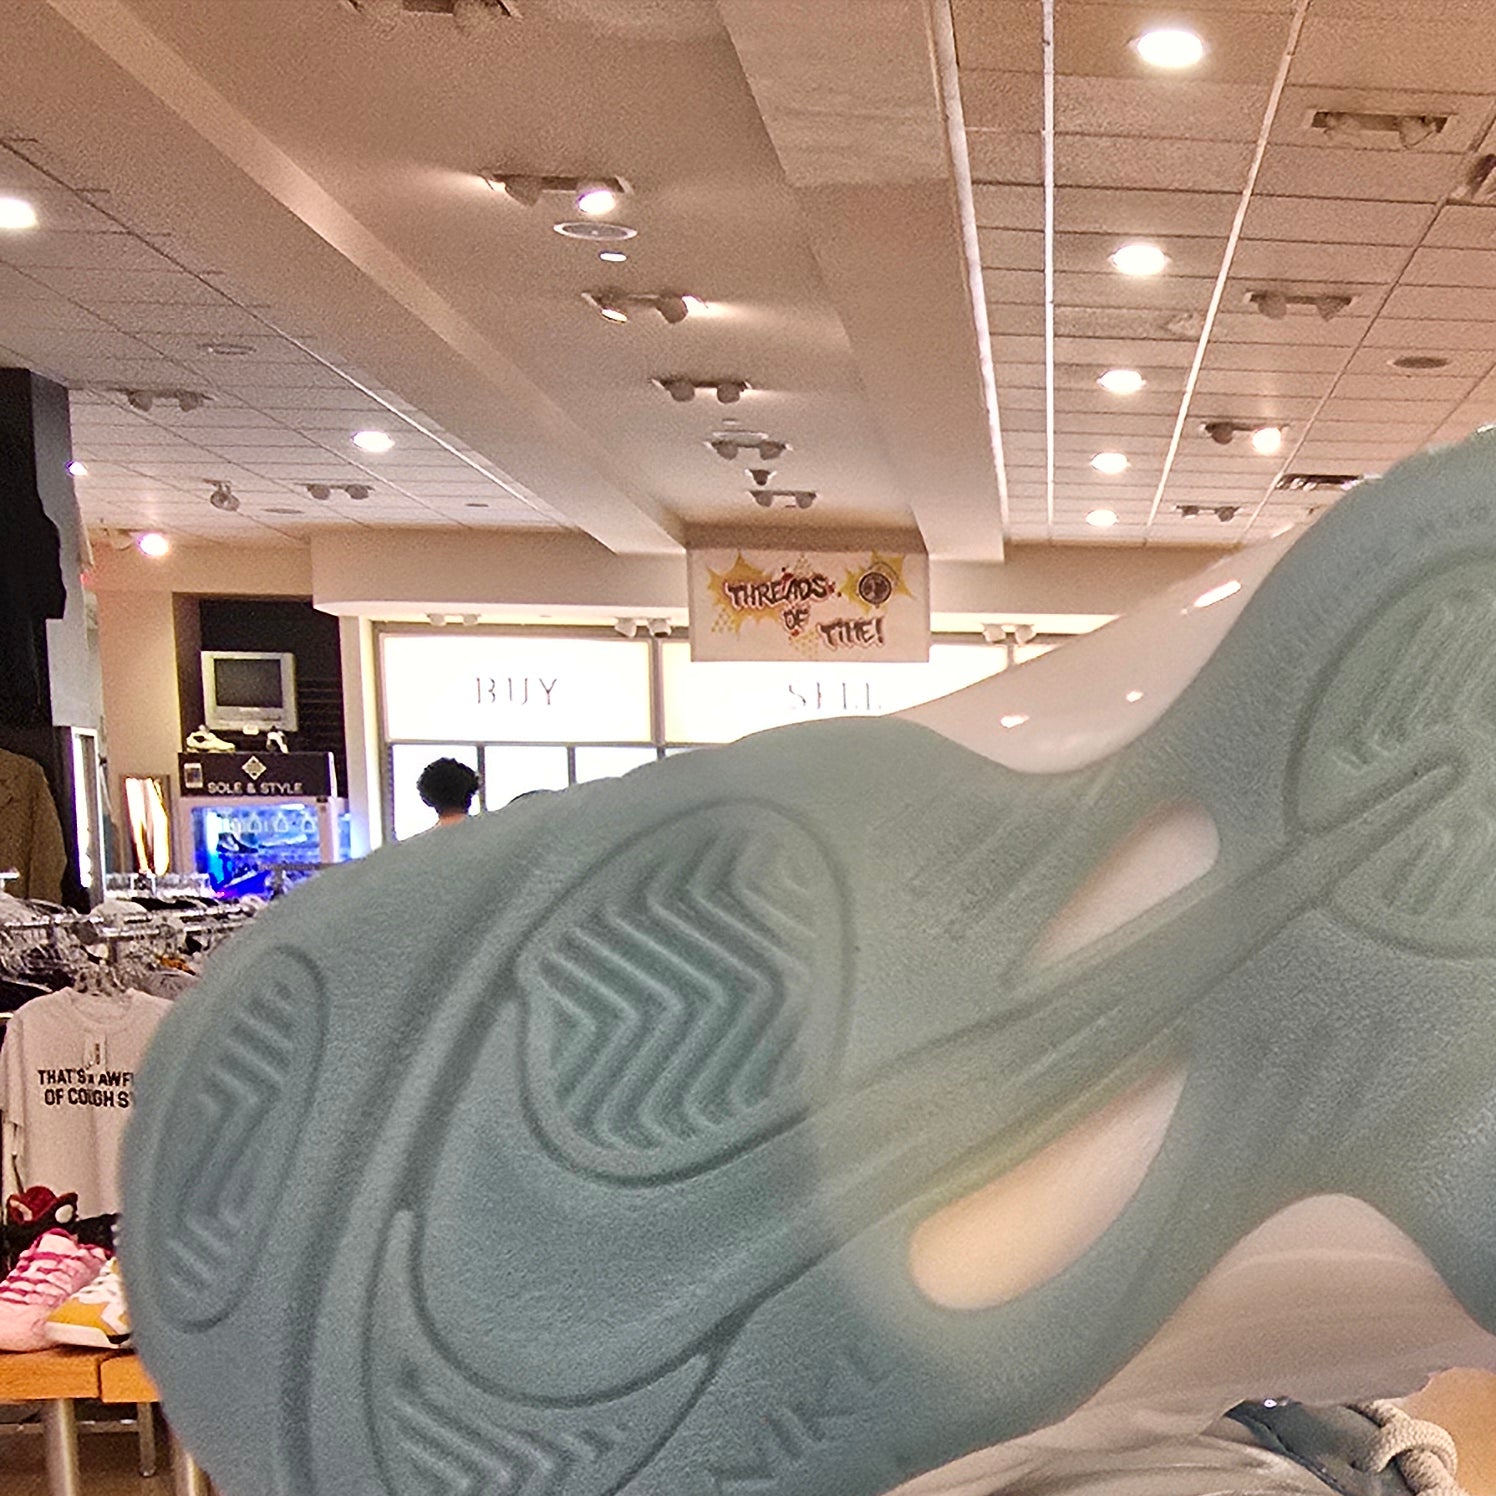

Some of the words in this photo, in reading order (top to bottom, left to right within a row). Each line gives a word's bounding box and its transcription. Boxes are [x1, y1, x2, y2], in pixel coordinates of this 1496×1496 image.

[726, 571, 830, 609] THREADS
[783, 605, 809, 631] OF
[476, 677, 558, 705] BUY
[207, 782, 242, 794] SOLE
[247, 782, 256, 794] &
[259, 782, 303, 794] STYLE
[37, 1068, 86, 1085] THAT'S
[44, 1088, 64, 1105] OF
